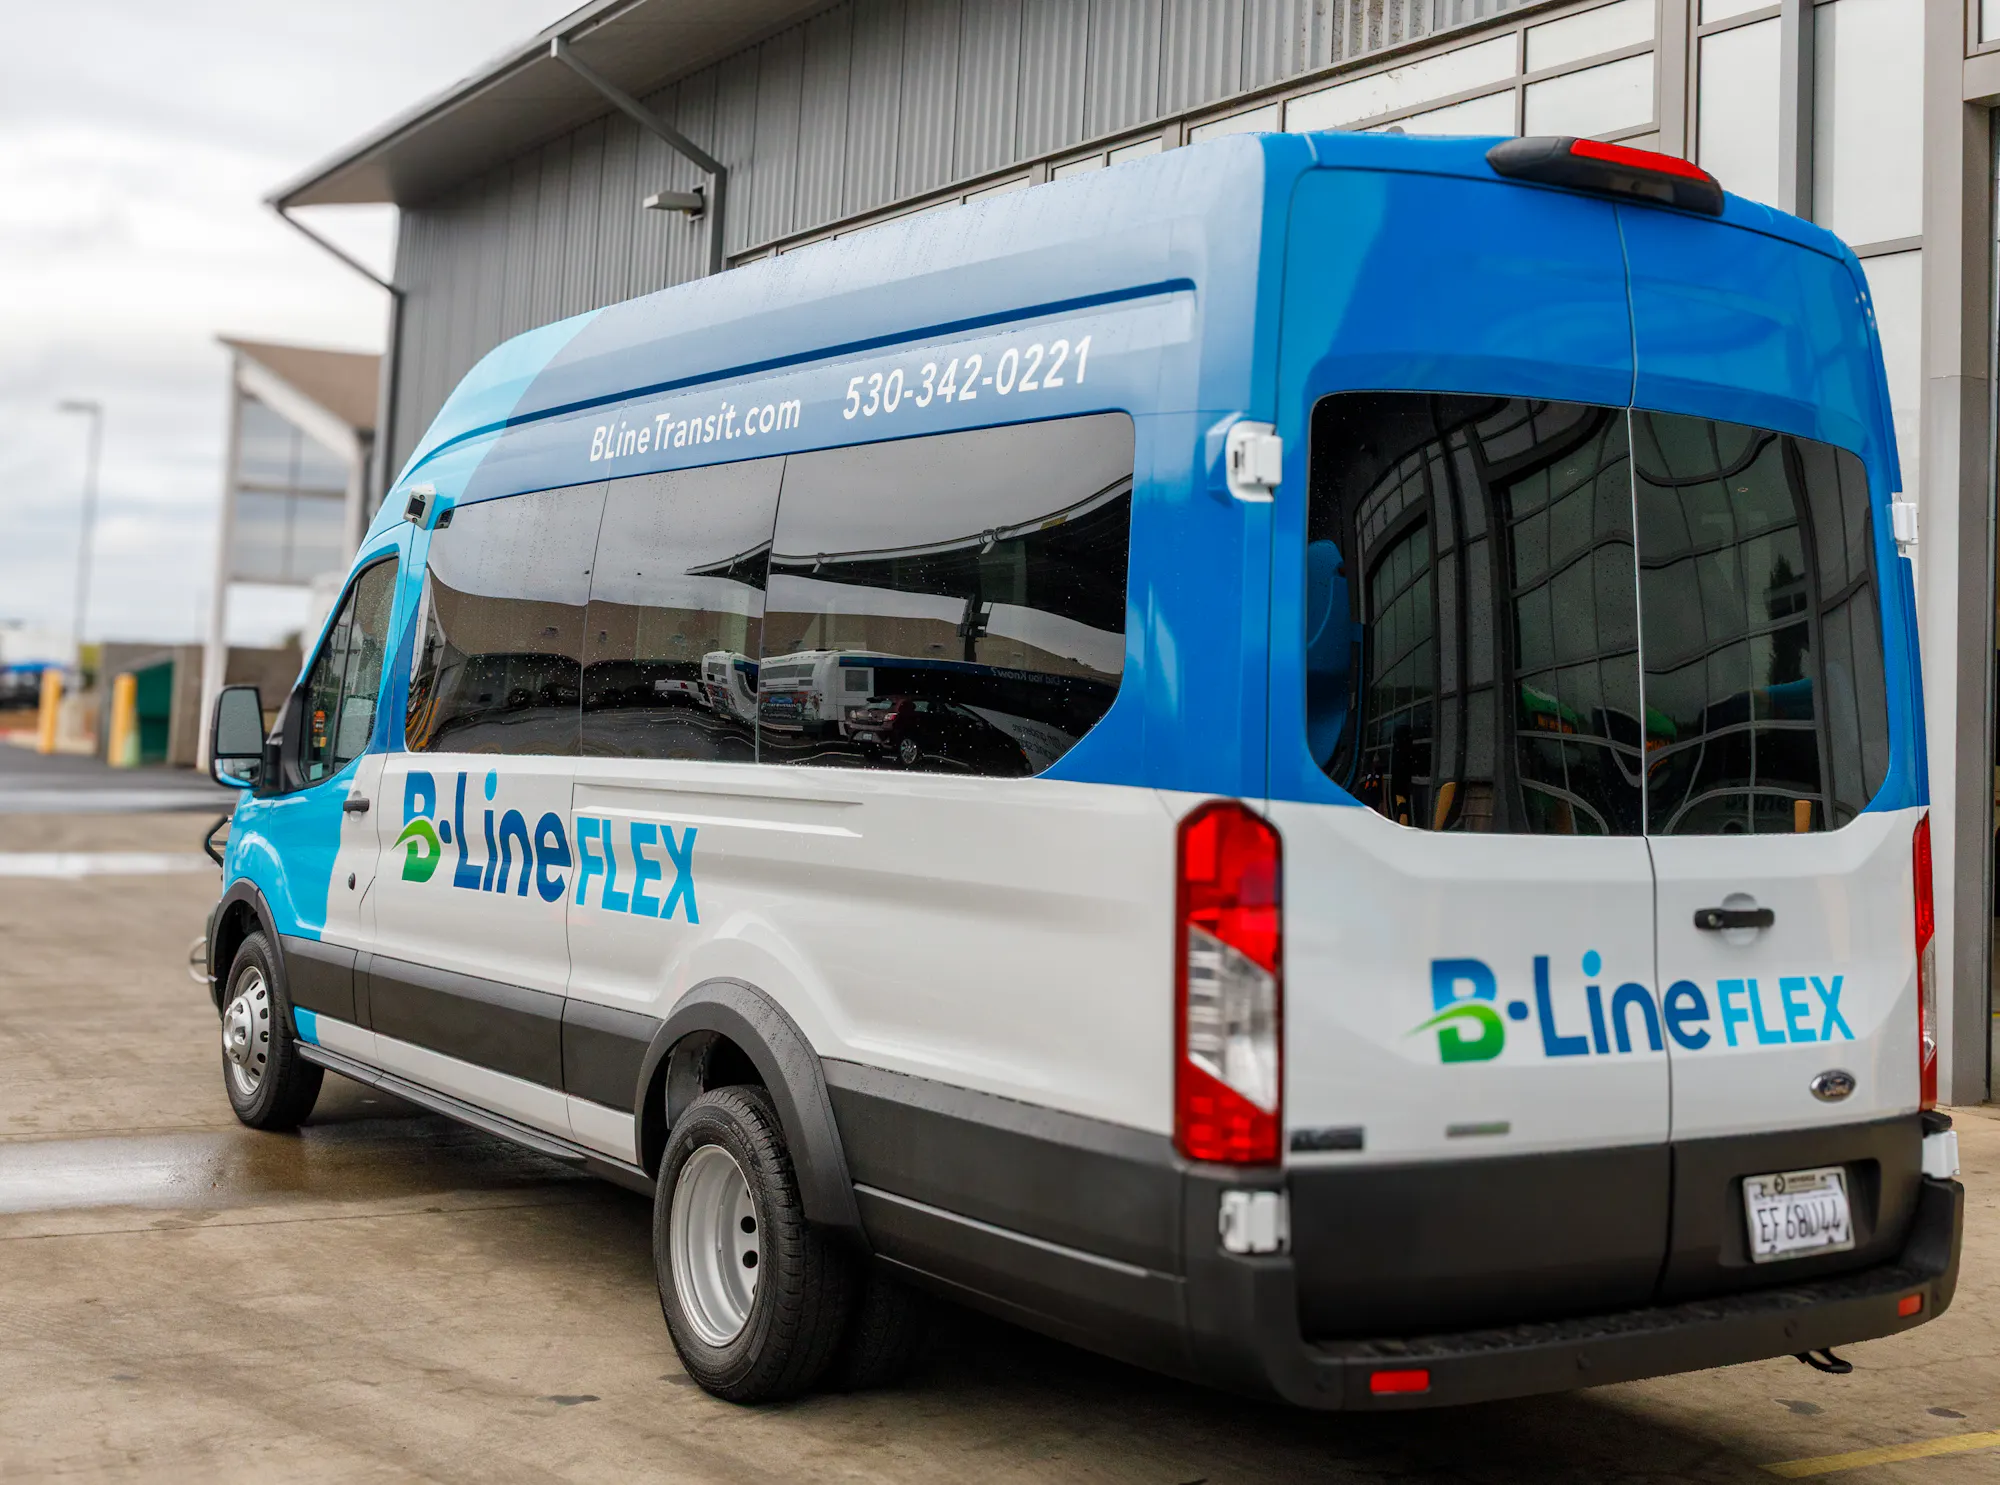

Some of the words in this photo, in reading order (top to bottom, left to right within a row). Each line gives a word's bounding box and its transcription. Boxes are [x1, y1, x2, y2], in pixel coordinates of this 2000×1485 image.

[590, 396, 801, 463] BLineTransit.com
[842, 334, 1093, 421] 530-342-0221
[576, 816, 700, 925] FLEX
[1717, 975, 1856, 1047] FLEX
